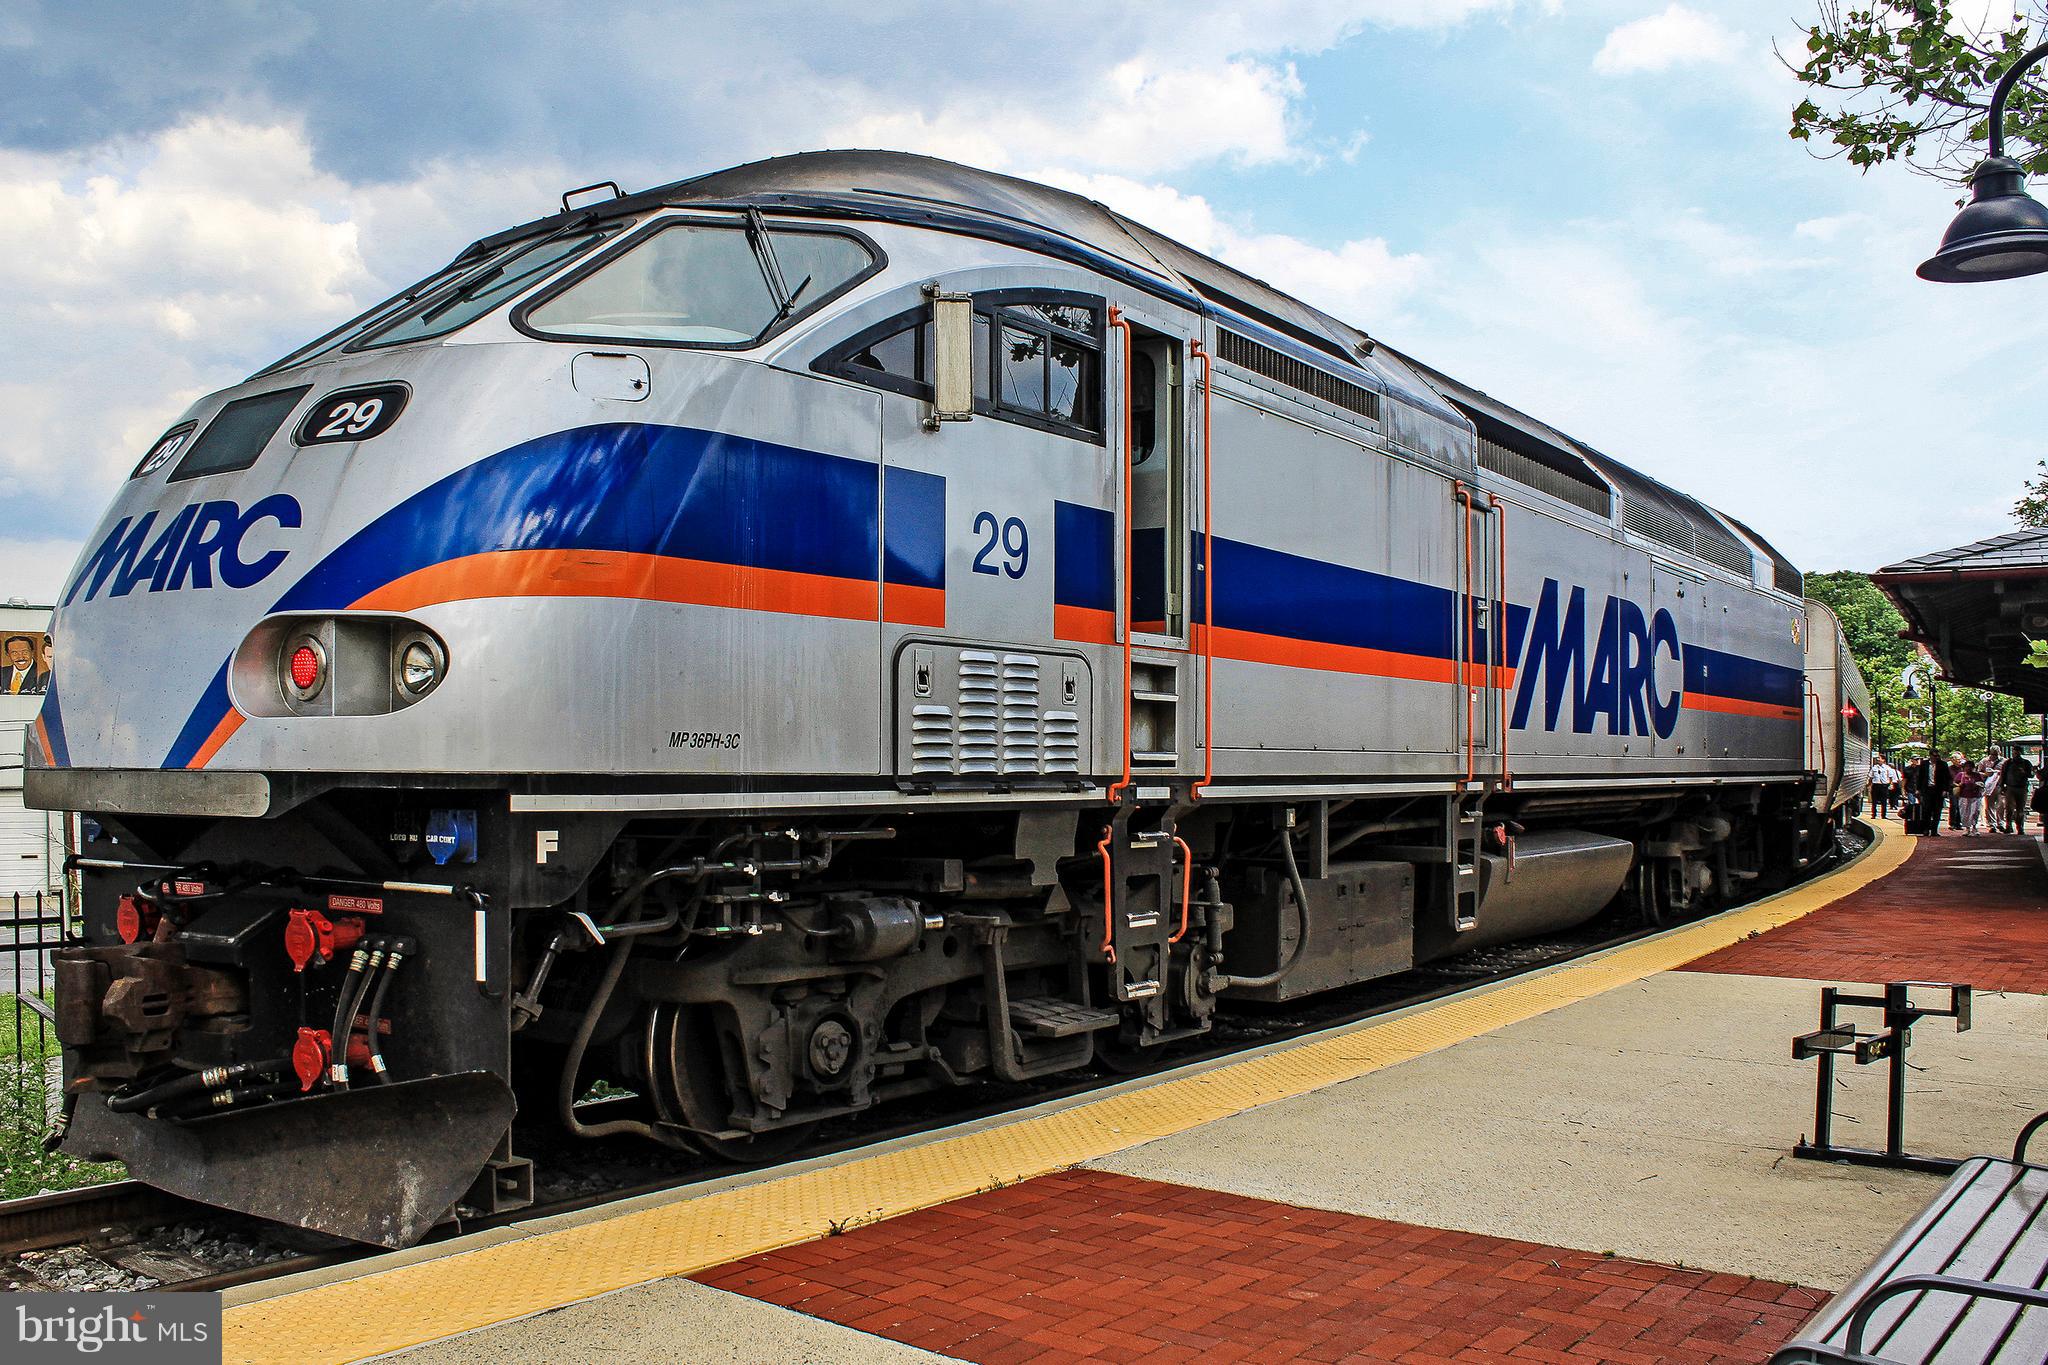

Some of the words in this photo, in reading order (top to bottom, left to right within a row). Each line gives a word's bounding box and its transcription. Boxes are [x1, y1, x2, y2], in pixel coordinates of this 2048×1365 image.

[316, 398, 383, 438] 29
[141, 435, 184, 474] 29
[63, 493, 303, 608] MARC
[972, 510, 1029, 580] 29
[1509, 577, 1681, 740] MARC
[425, 834, 439, 843] CAR
[536, 830, 559, 864] F
[332, 897, 355, 908] DANGER
